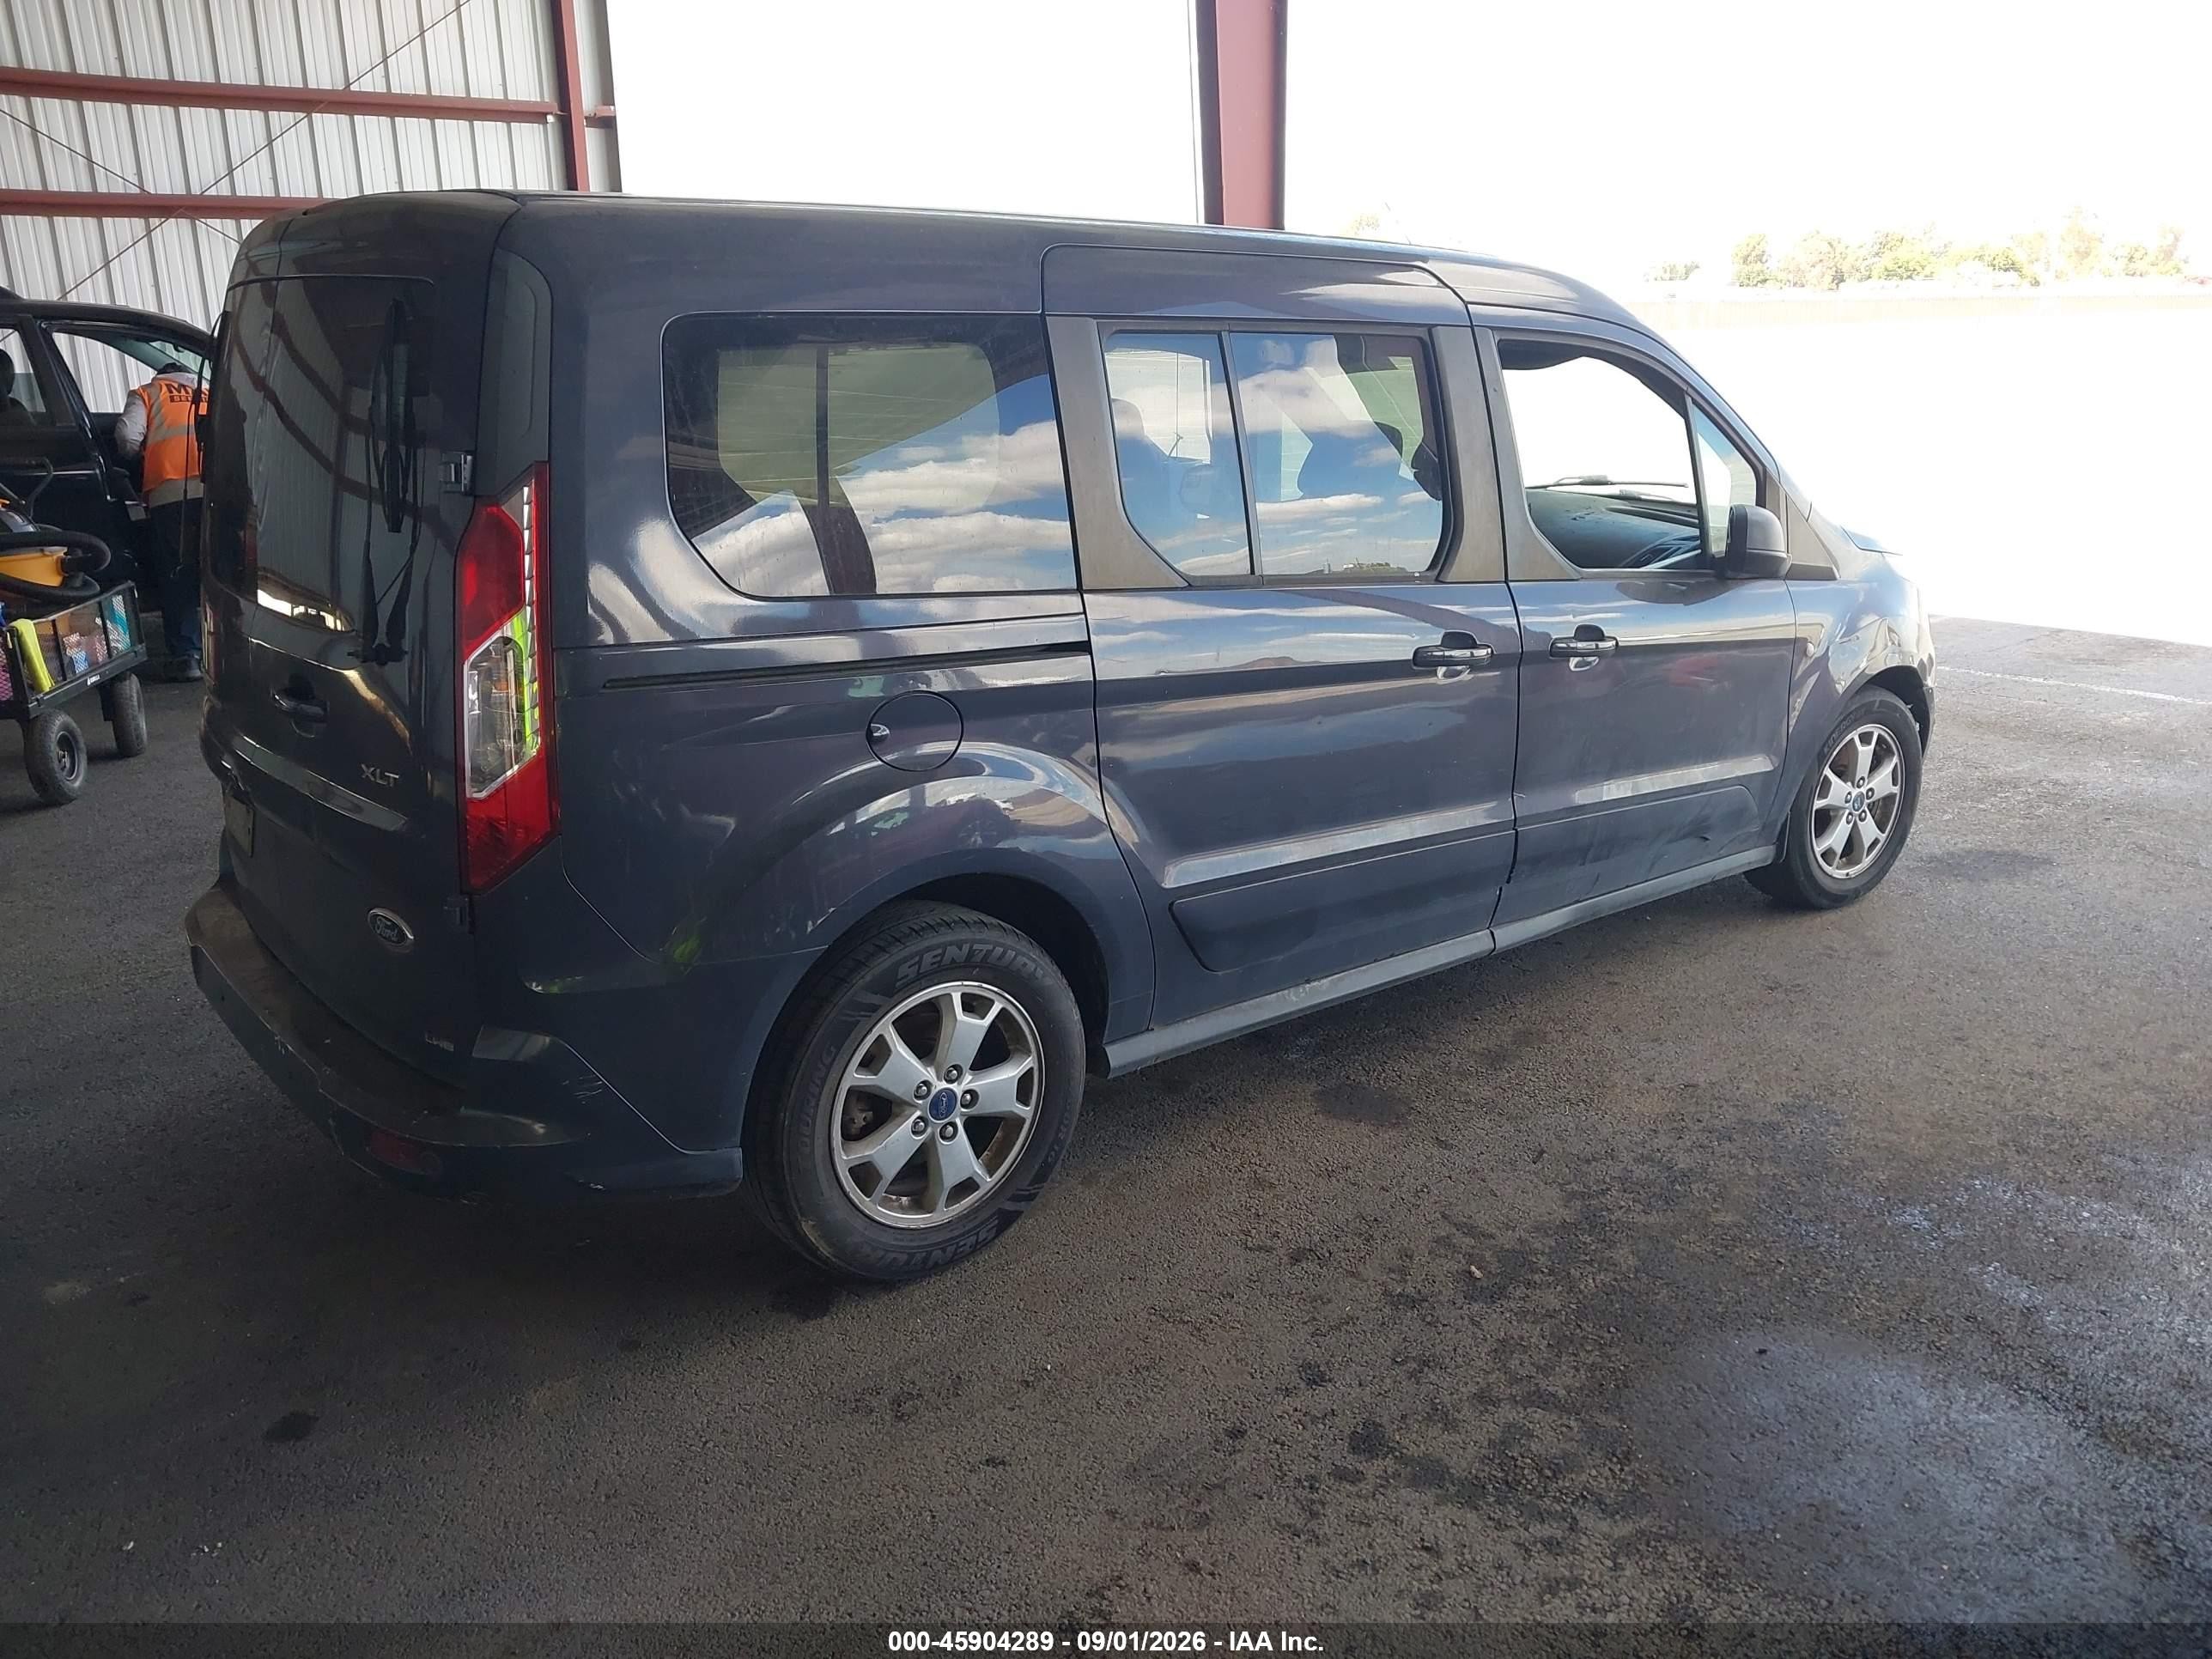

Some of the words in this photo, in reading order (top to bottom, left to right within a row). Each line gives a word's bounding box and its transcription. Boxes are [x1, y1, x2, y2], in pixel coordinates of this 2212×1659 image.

[361, 763, 399, 787] XLT
[374, 915, 398, 943] Ford
[896, 943, 1051, 986] SENTURY
